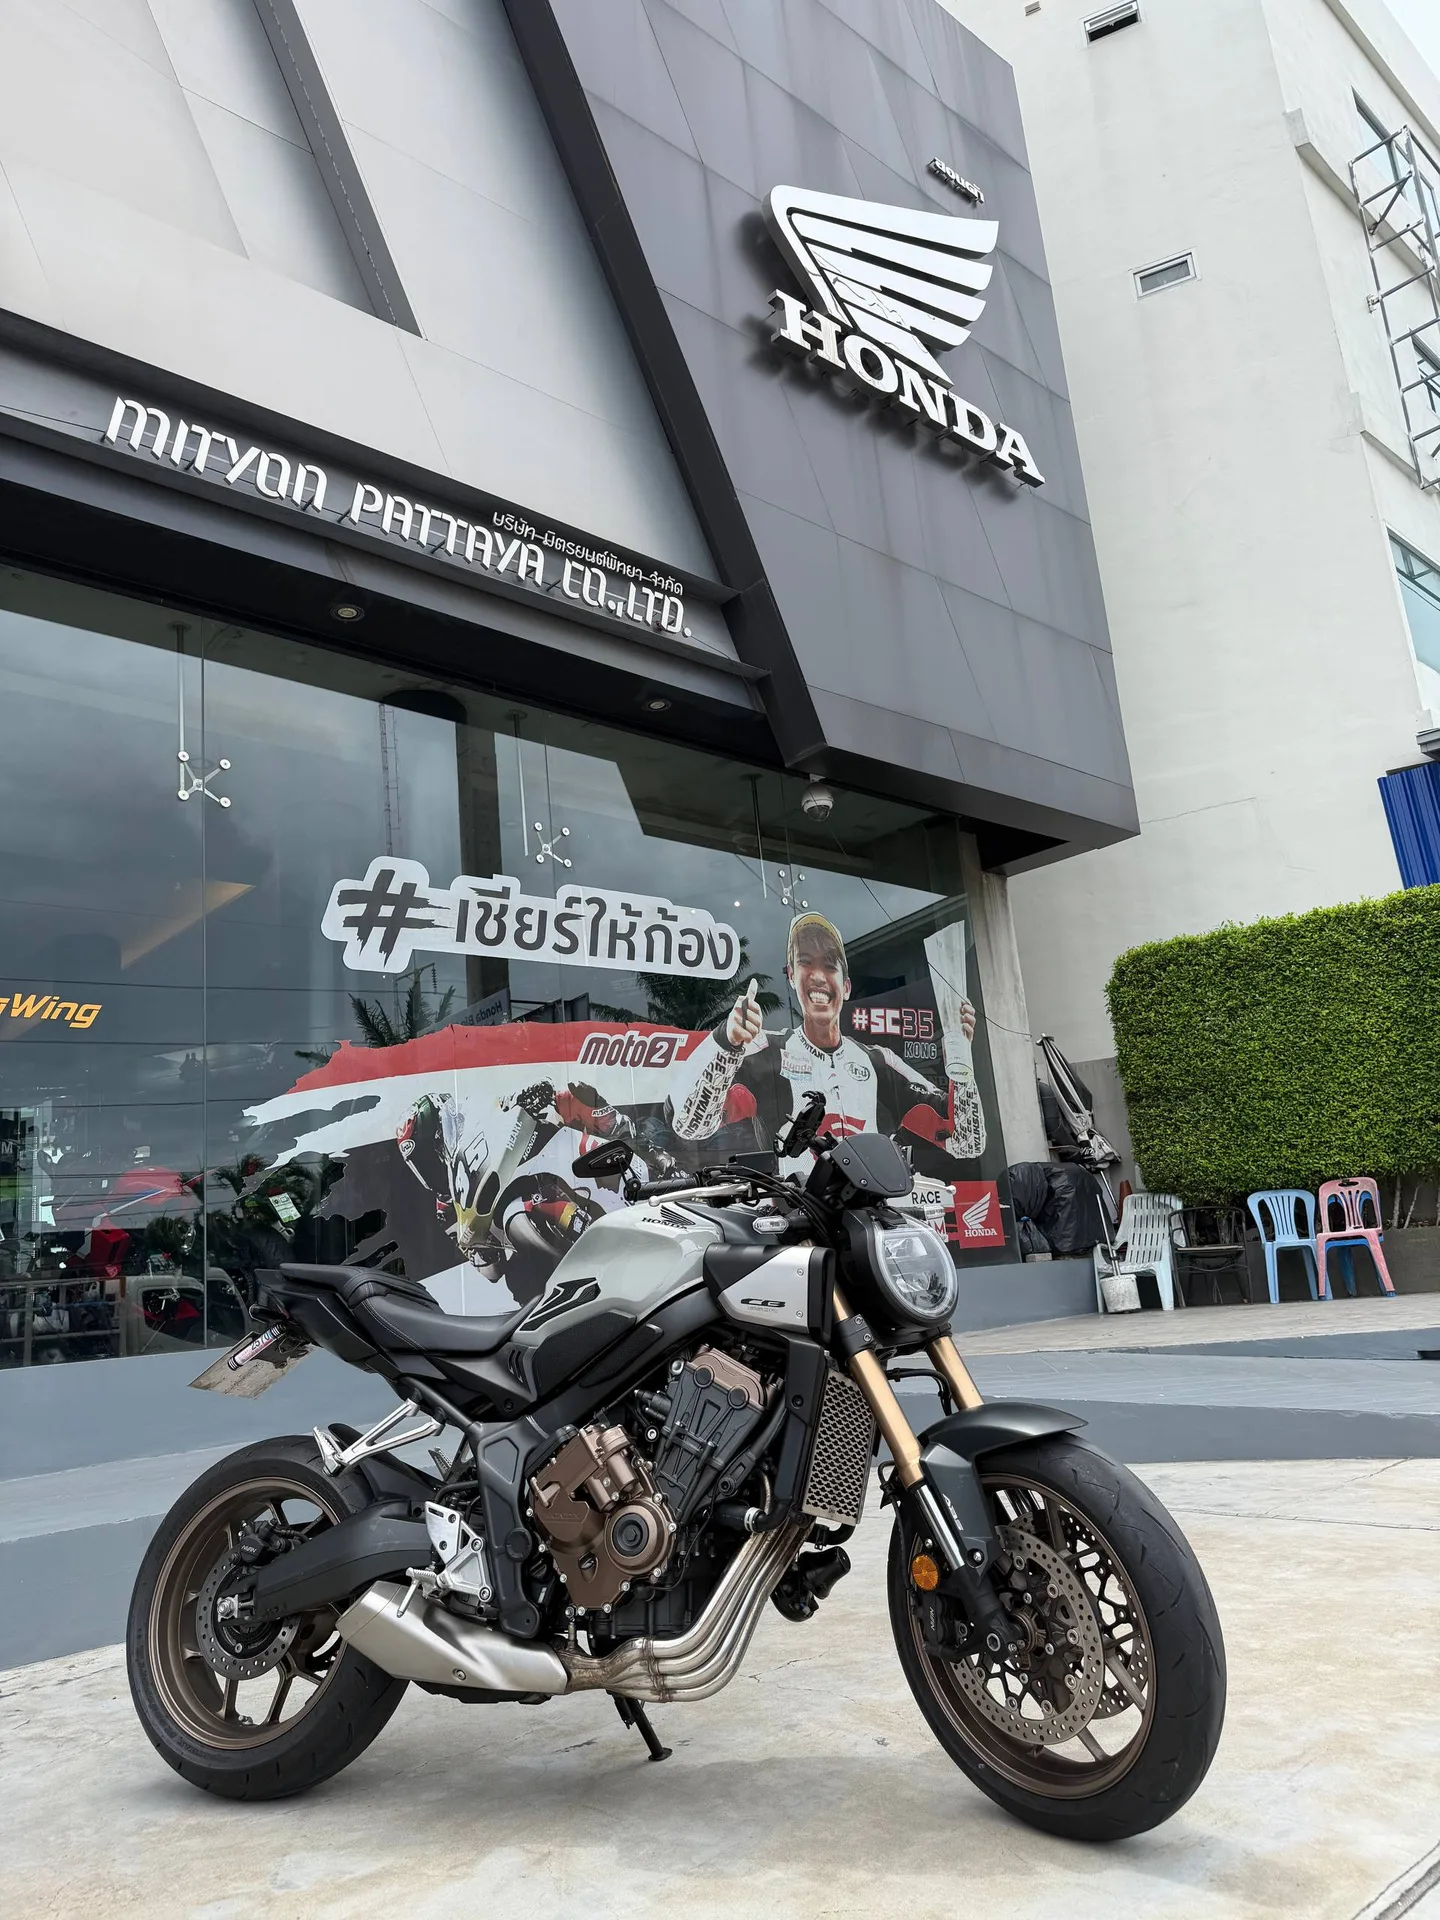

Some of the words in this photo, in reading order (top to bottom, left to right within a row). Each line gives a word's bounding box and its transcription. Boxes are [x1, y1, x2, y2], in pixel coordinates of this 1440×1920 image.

[768, 288, 1046, 488] HONDA
[349, 481, 545, 588] PATTAYA
[852, 1007, 935, 1040] #SC35
[904, 1041, 938, 1059] KONG
[911, 1191, 941, 1204] RACE
[964, 1228, 998, 1238] HONDA
[741, 1298, 786, 1308] CB
